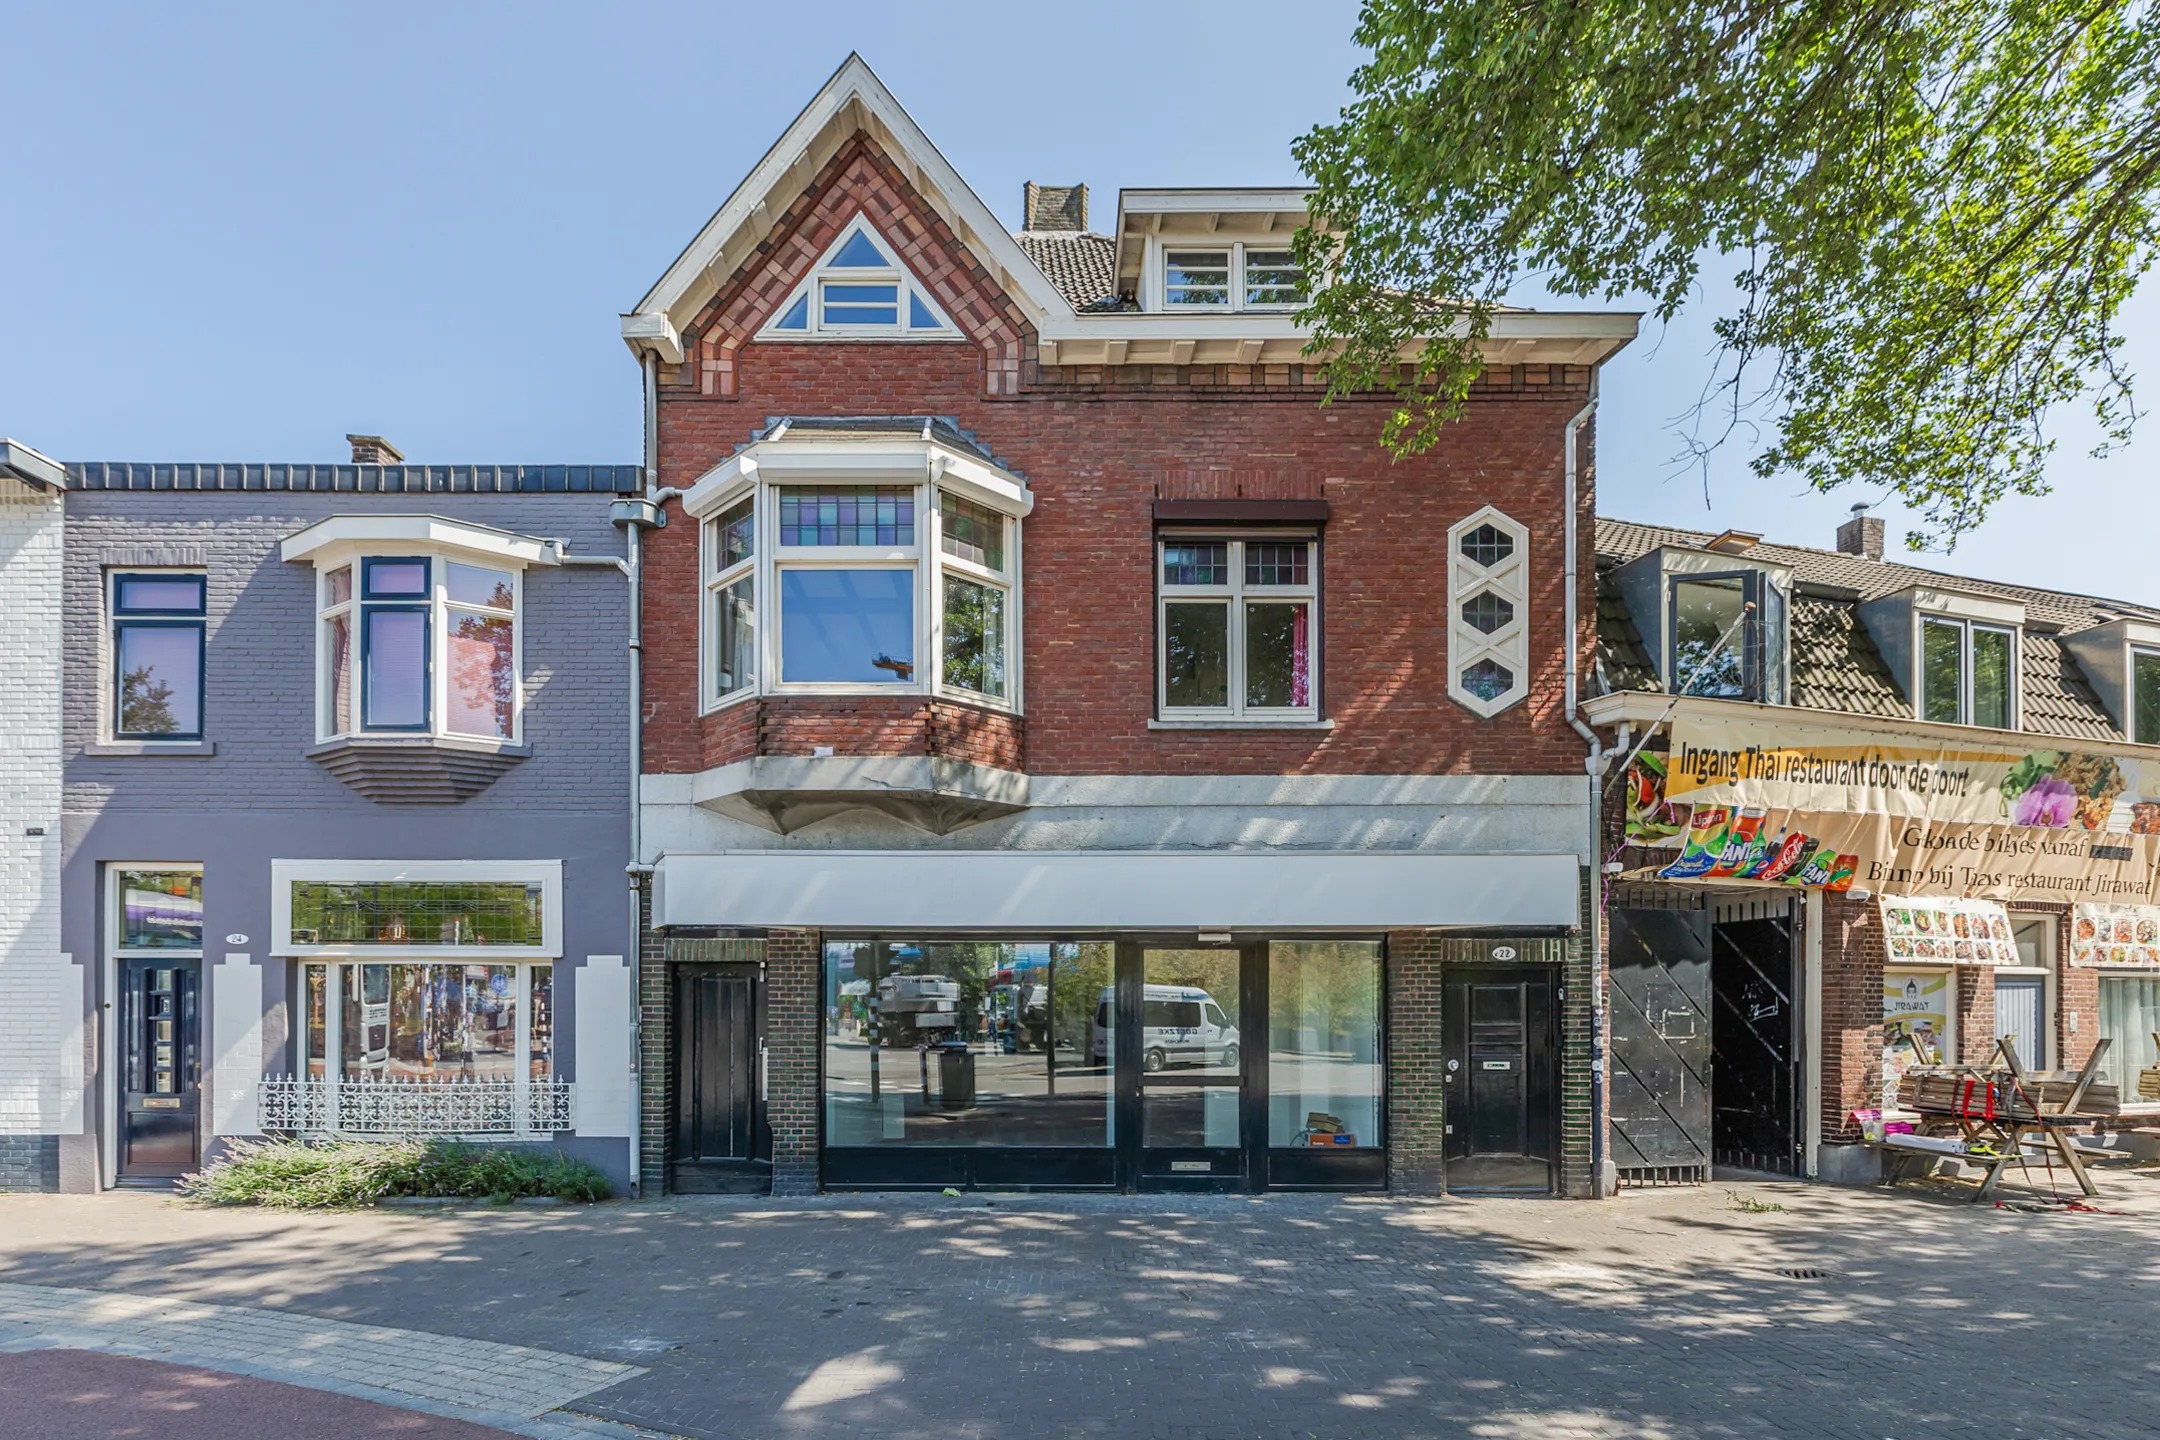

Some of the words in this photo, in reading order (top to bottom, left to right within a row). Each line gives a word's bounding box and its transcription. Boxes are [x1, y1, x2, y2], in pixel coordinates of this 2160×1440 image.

[1680, 742, 1740, 787] Ingang
[1745, 745, 1781, 781] Thai
[1784, 752, 1866, 786] restaurant
[1869, 755, 1907, 790] door
[1908, 759, 1929, 793] de
[1930, 864, 1954, 890] bij
[2007, 873, 2091, 892] restaurant
[2092, 874, 2153, 896] Jirawat
[231, 934, 242, 943] 24
[1500, 949, 1511, 958] 22
[1893, 1001, 1930, 1011] JIRAWAT
